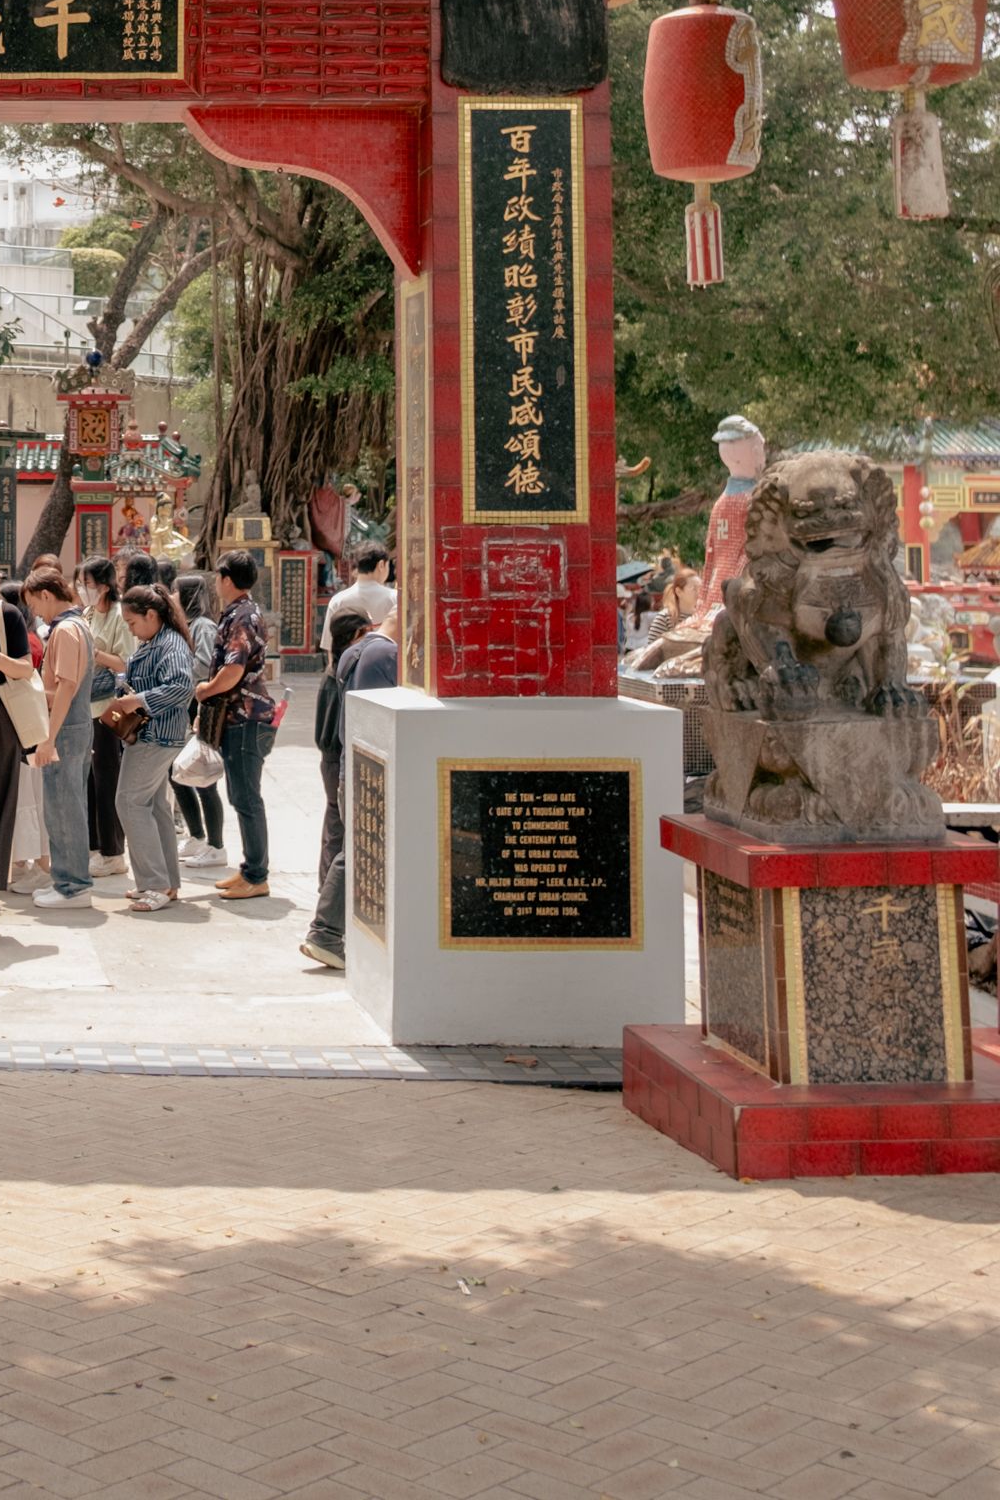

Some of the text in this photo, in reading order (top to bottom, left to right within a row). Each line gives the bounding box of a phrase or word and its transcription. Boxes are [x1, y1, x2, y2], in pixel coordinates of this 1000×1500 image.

[505, 793, 518, 802] THE
[560, 793, 576, 802] GATE
[496, 807, 512, 817] GATE
[514, 807, 522, 817] OF
[526, 807, 530, 817] A
[533, 807, 564, 817] THOUSAND
[568, 807, 585, 817] YEAR
[512, 821, 569, 830] TO COMMEMORATE
[505, 836, 577, 844] THE CENTENARY YEAR
[501, 850, 510, 859] OF
[514, 850, 526, 859] THE
[529, 850, 550, 859] URBAN
[514, 864, 567, 873] WAS OPENED BY
[493, 892, 525, 902] CHAIRMAN
[527, 892, 536, 902] OF
[504, 907, 512, 916] ON
[536, 907, 559, 916] MARCH
